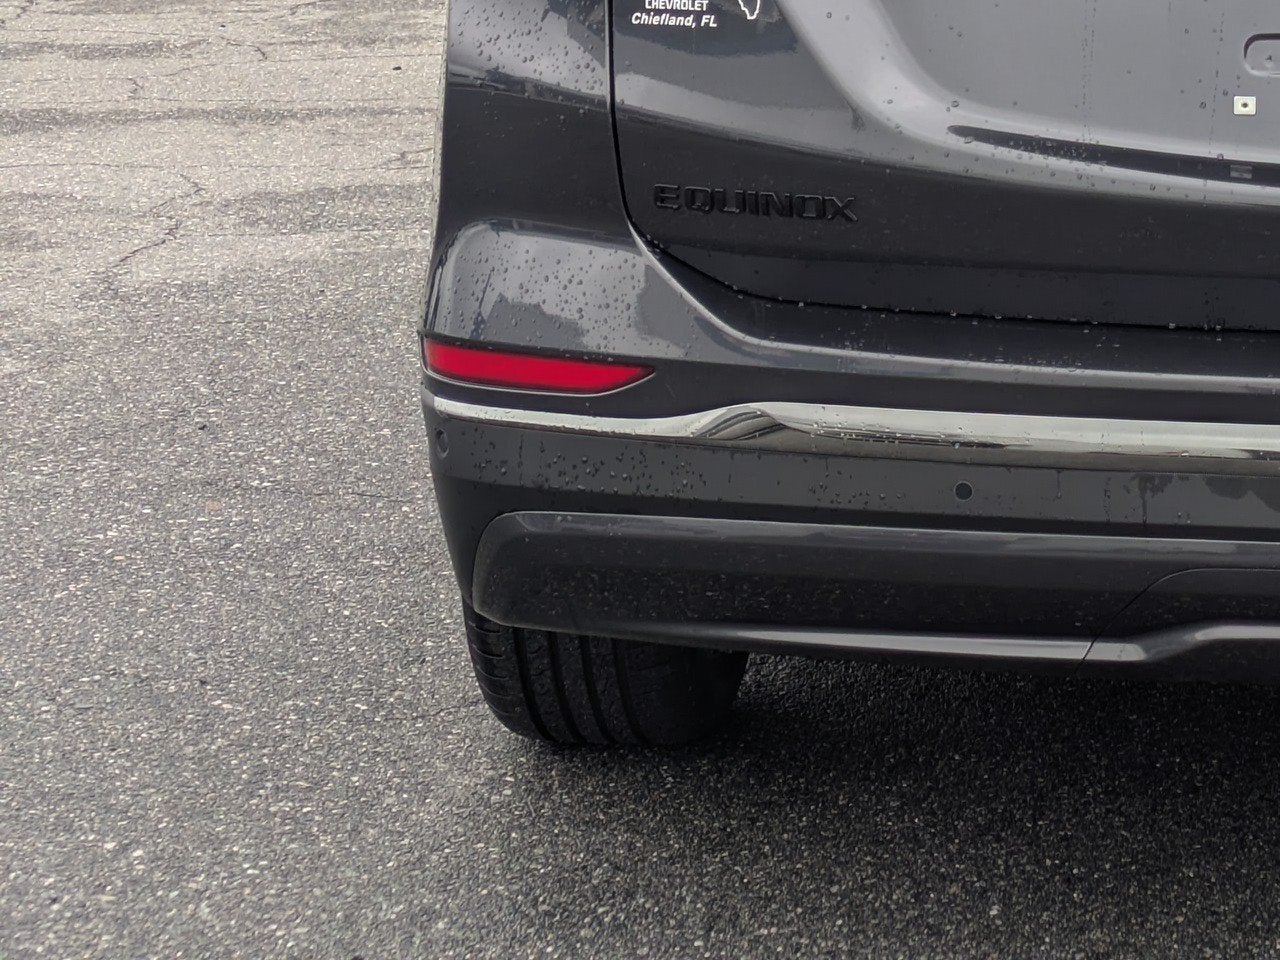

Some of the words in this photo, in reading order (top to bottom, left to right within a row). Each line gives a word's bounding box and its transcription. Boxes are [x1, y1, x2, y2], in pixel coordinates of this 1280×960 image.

[631, 12, 696, 29] Chiefland,
[700, 15, 718, 28] FL
[653, 183, 858, 222] EQUINOX
